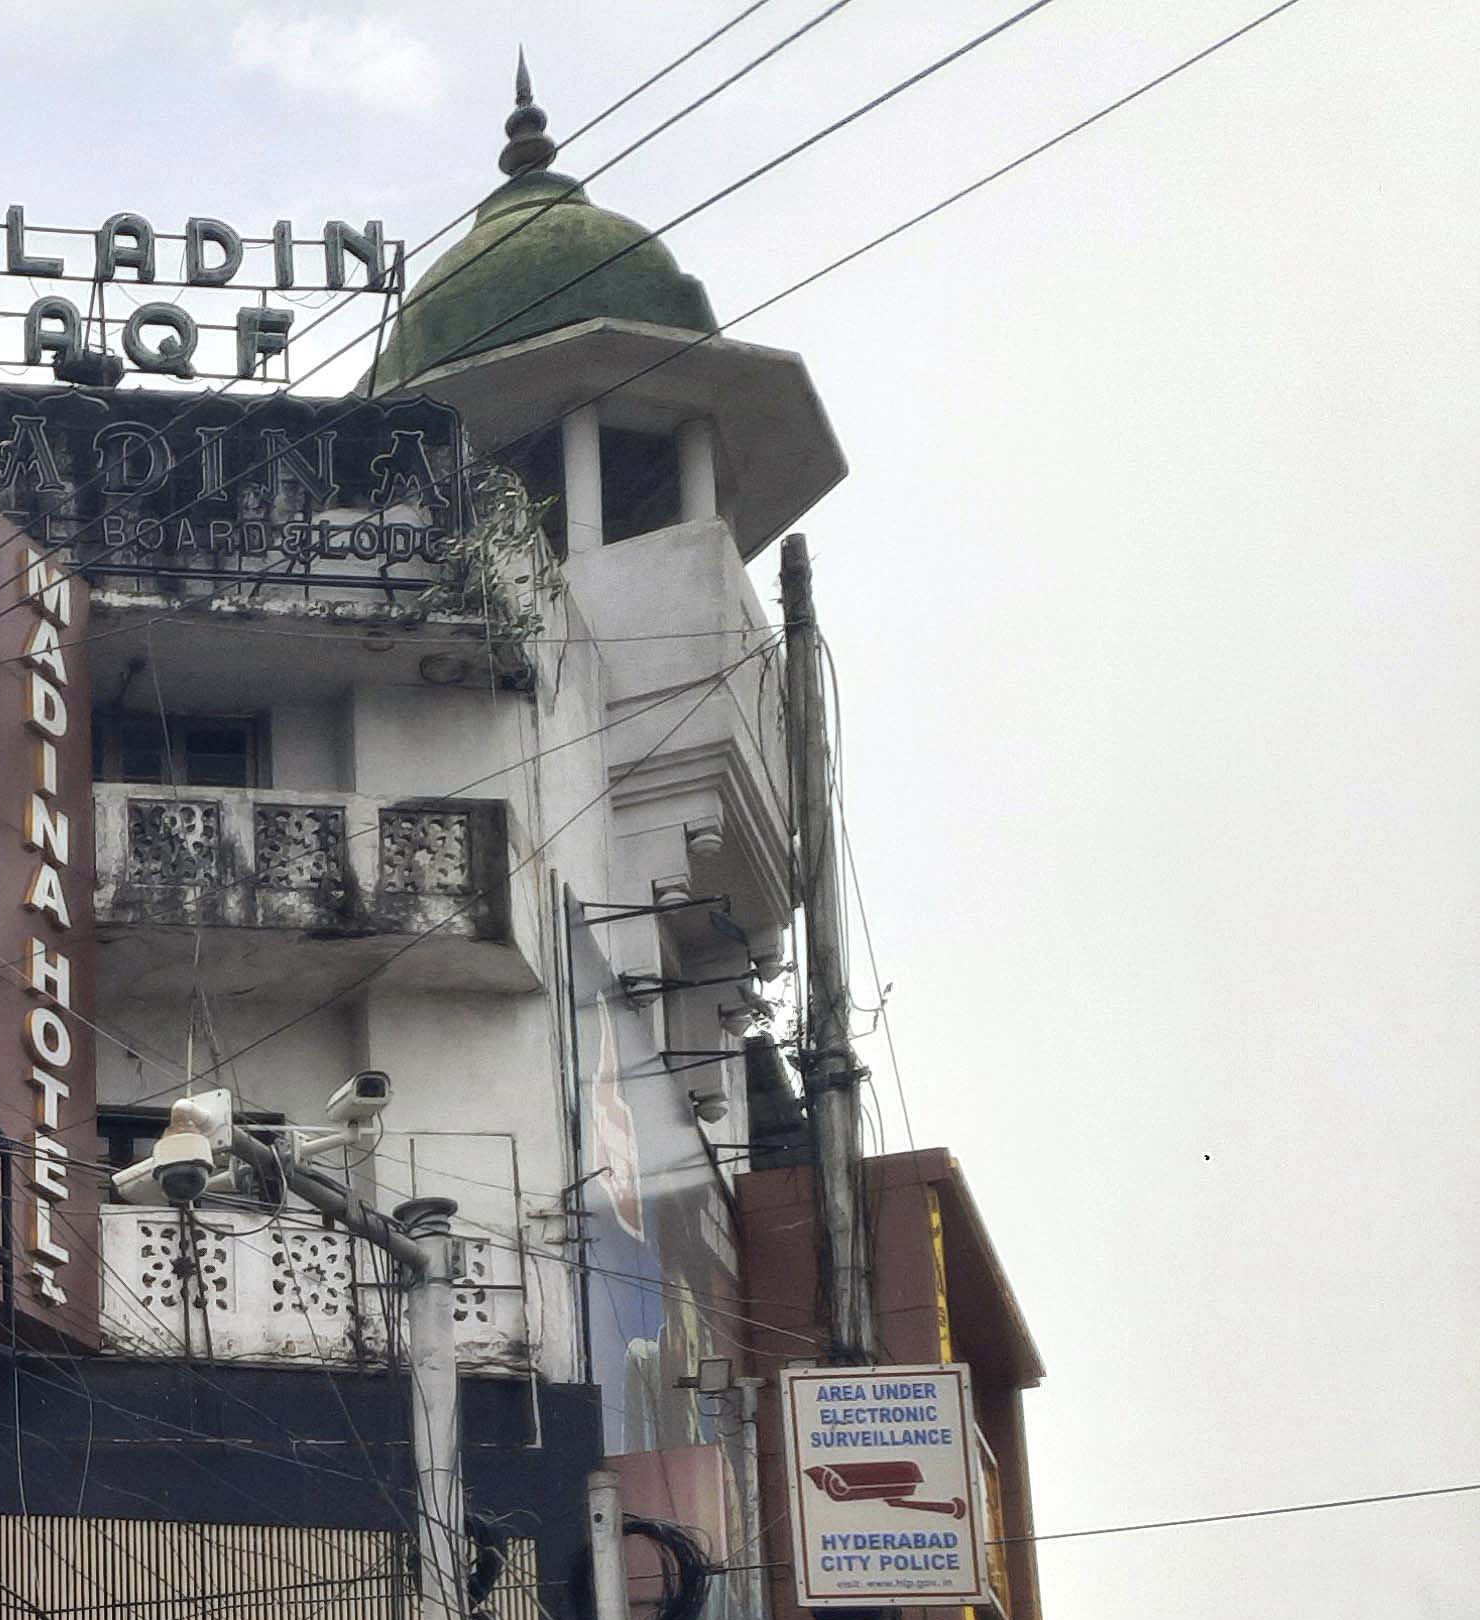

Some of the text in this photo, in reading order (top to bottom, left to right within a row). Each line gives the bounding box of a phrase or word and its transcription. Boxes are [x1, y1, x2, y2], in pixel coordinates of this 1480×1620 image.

[103, 515, 269, 557] BOARD
[26, 546, 72, 930] MADINA
[816, 1383, 937, 1402] AREA UNDER
[820, 1405, 938, 1425] ELECTRONIC
[810, 1428, 953, 1448] SURVEILLANCE
[821, 1531, 959, 1551] HYDERABAD
[820, 1553, 961, 1572] CITY POLICE
